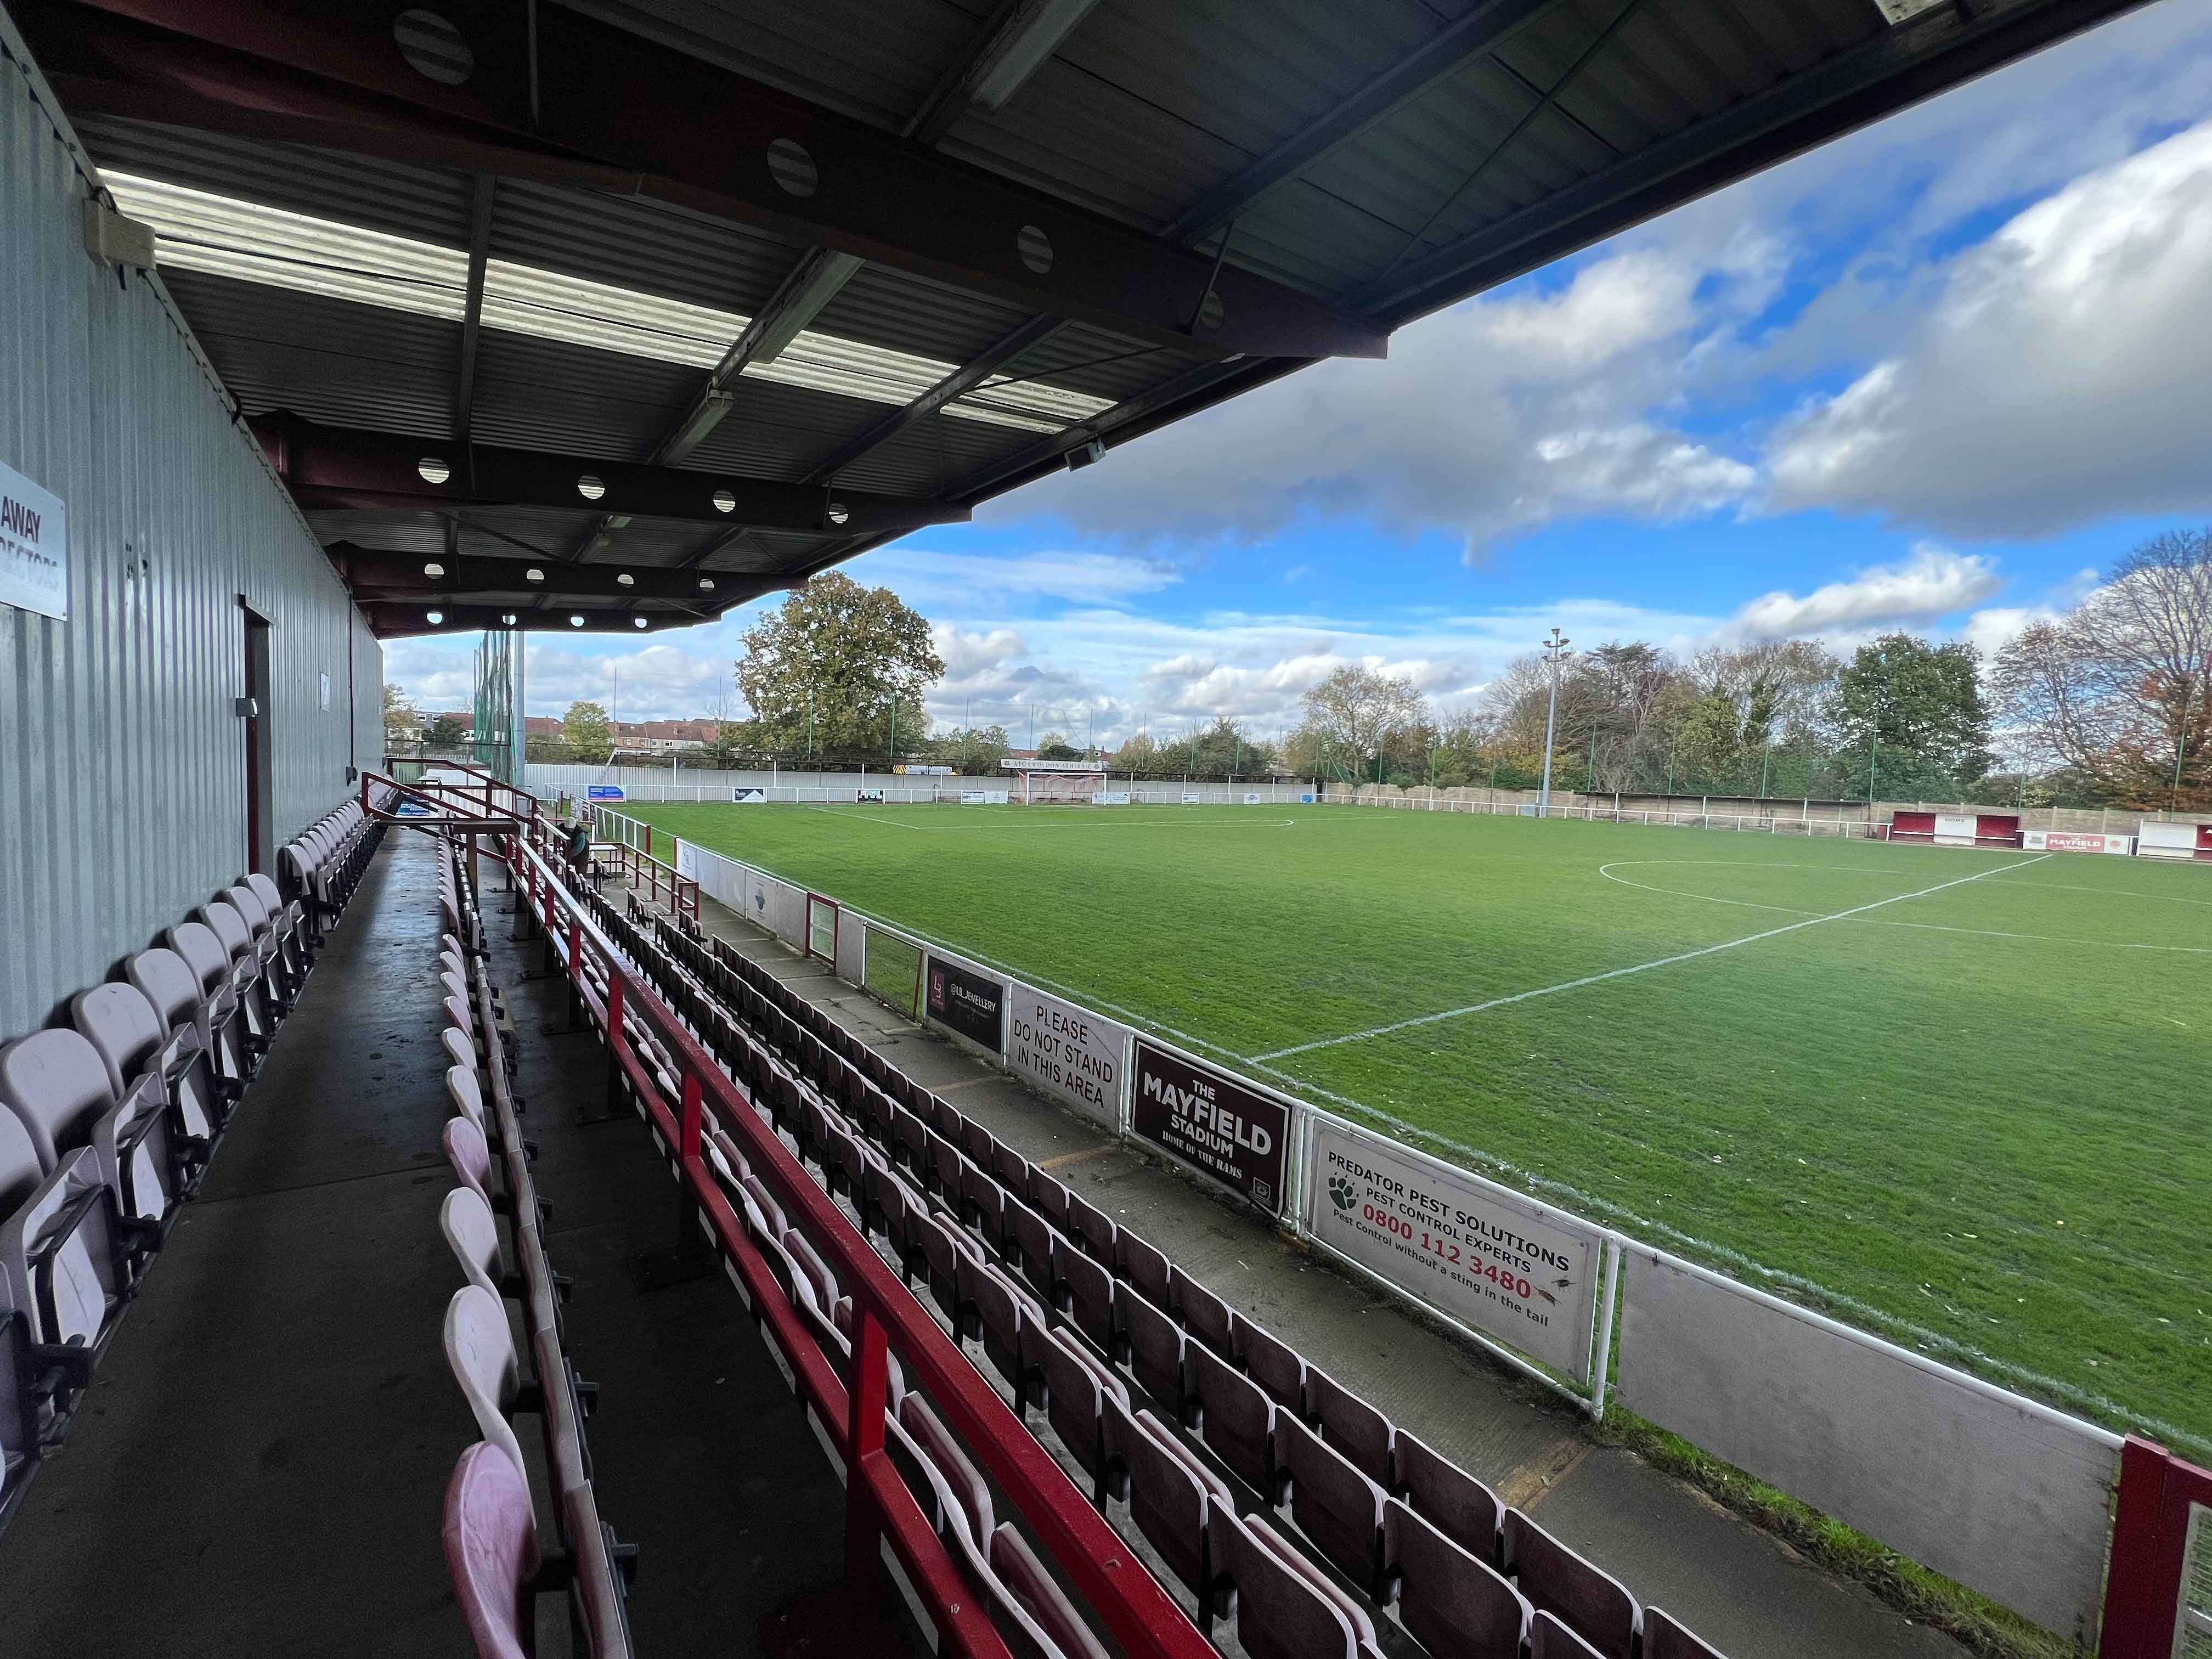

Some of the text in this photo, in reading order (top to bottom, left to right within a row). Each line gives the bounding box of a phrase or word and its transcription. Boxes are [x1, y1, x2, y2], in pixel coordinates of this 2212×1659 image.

[1, 495, 41, 544] AWAY
[2049, 838, 2101, 847] MAYFIELD
[950, 983, 996, 1012] @LB_JEWELLERY
[1036, 1005, 1088, 1045] PLEASE
[1014, 1019, 1113, 1083] DO NOT STAND
[1018, 1045, 1104, 1108] IN THIS AREA
[1143, 1071, 1272, 1155] MAYFIELD
[1193, 1079, 1216, 1101] THE
[1163, 1130, 1243, 1179] HOME OF THE RAMS
[1171, 1114, 1233, 1159] STADIUM
[1328, 1151, 1569, 1271] PREDATOR PEST SOLUTIONS
[1367, 1187, 1531, 1273] PEST CONTROL EXPERTS
[1334, 1209, 1548, 1327] Pest Control without a sting in the tail
[1363, 1204, 1531, 1299] 0800 112 3480
